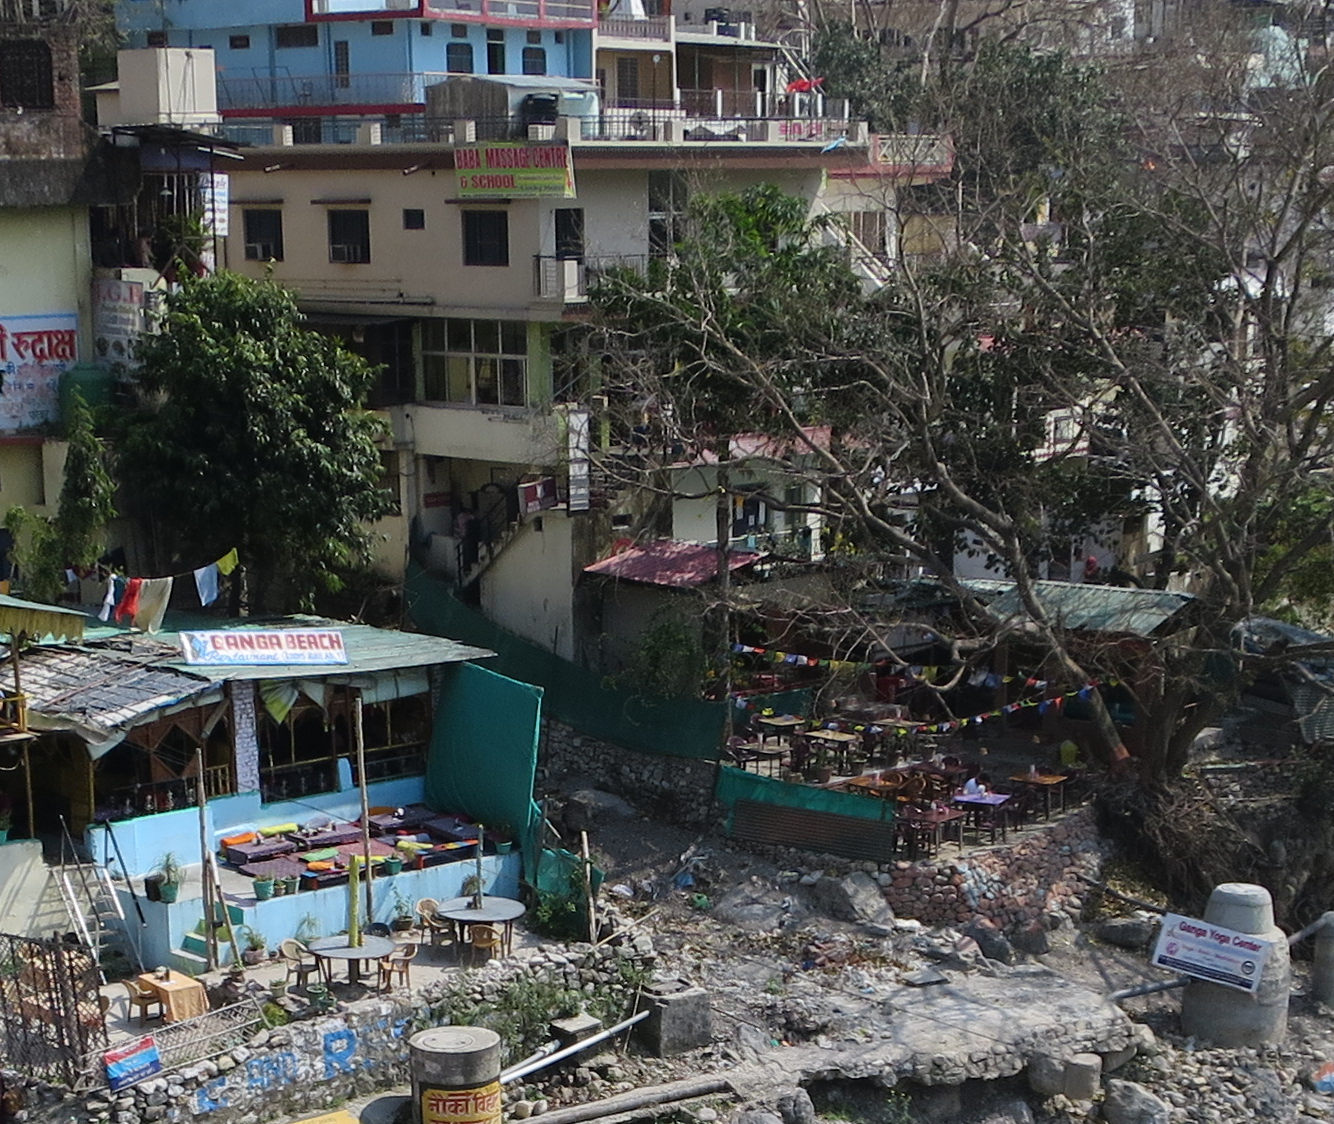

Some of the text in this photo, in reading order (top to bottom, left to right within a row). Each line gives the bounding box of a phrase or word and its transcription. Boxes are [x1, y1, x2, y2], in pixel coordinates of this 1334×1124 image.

[455, 149, 481, 170] BABA
[485, 147, 530, 169] MASSAGE
[471, 174, 518, 189] SCHOOL
[10, 328, 77, 365] रुद्राक्ष
[210, 632, 342, 651] GANGA BEACH
[1179, 921, 1263, 953] Ganga Yoga Center
[427, 1091, 472, 1116] नौका
